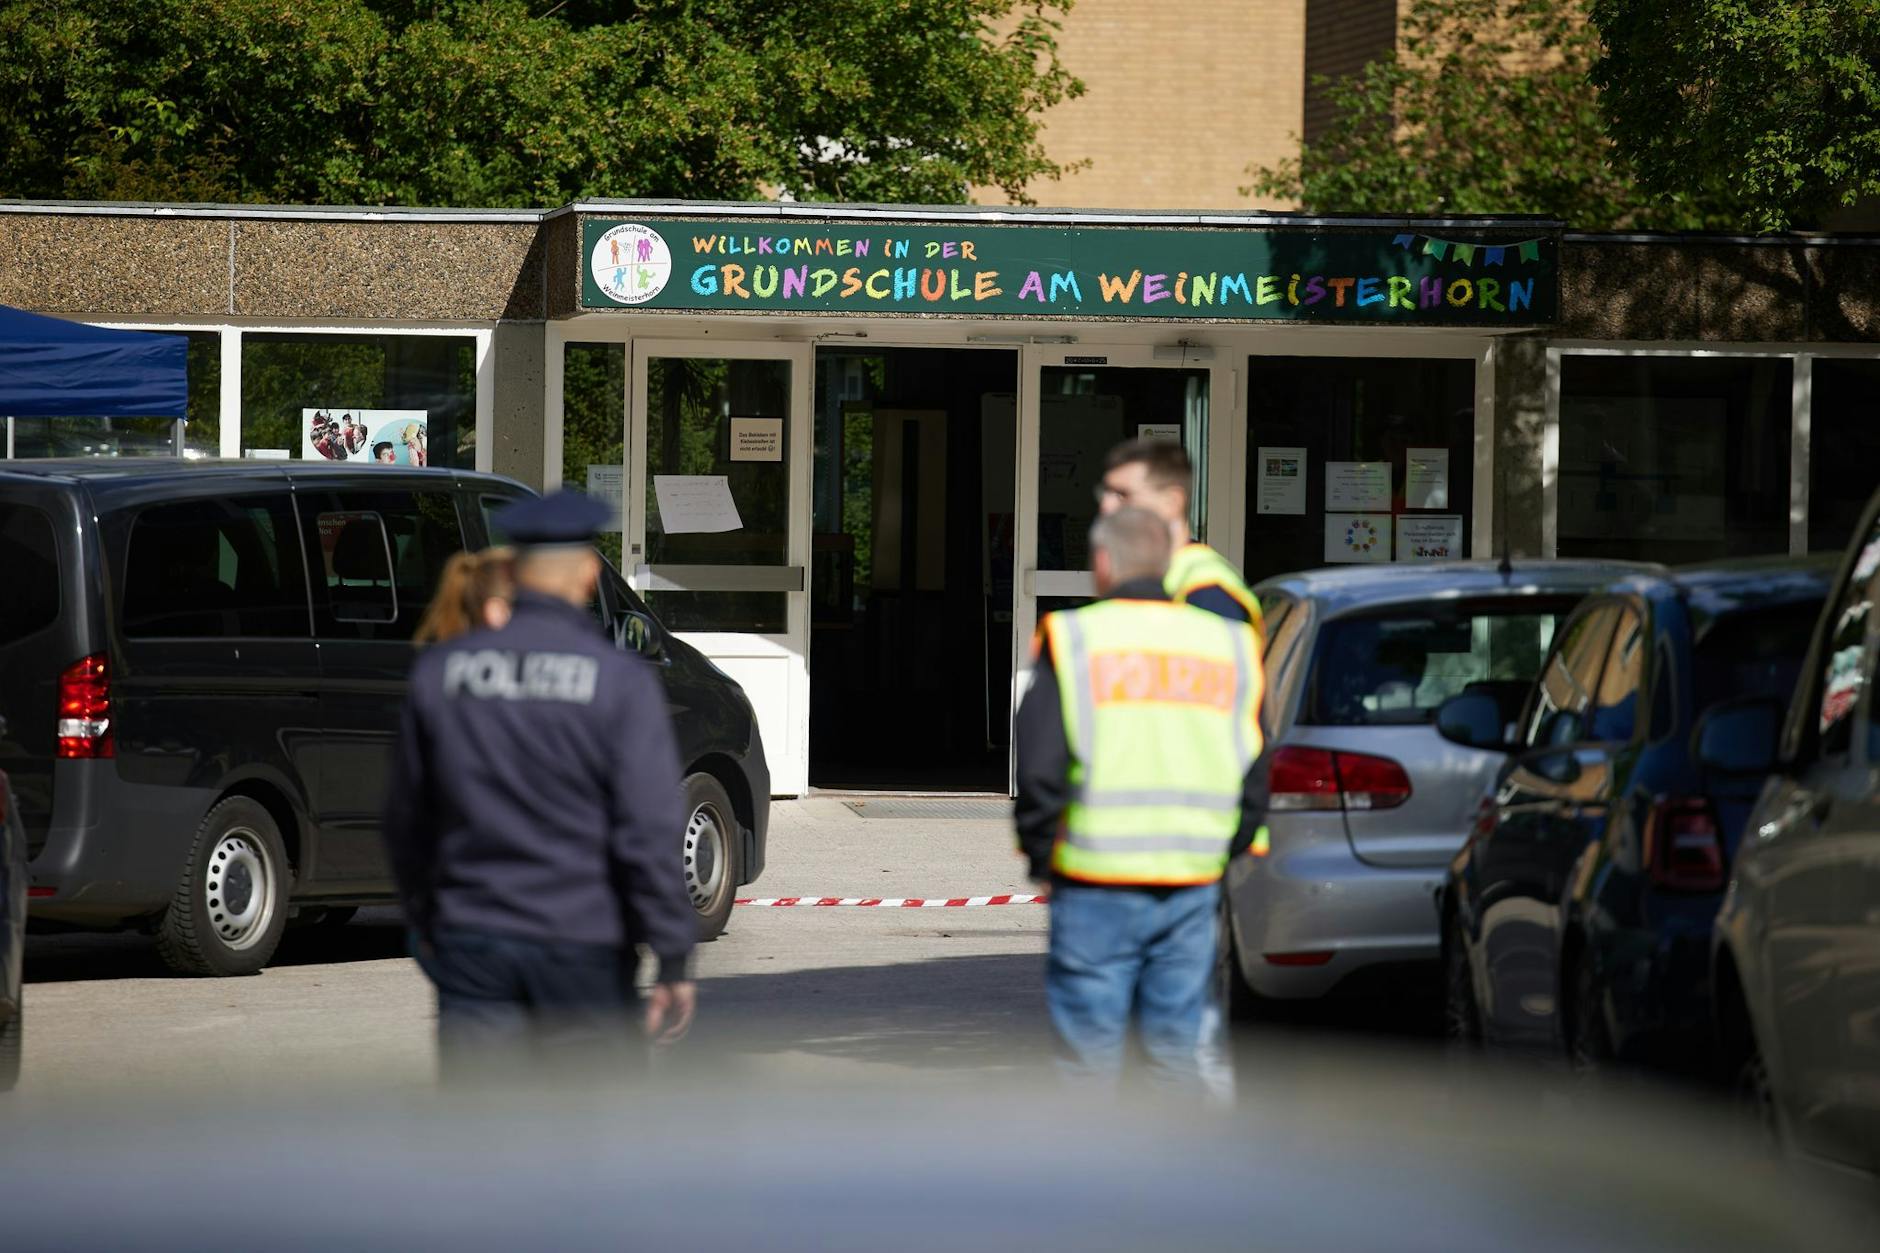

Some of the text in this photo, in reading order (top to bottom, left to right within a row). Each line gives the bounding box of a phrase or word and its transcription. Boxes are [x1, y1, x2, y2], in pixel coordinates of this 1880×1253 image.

[604, 225, 660, 243] Grundschule am
[924, 240, 977, 261] DER
[603, 284, 660, 301] Weinmeisterhorn
[690, 263, 1003, 301] GRUNDSCHULE
[1018, 270, 1082, 303] AM
[444, 650, 598, 705] POLIZEI
